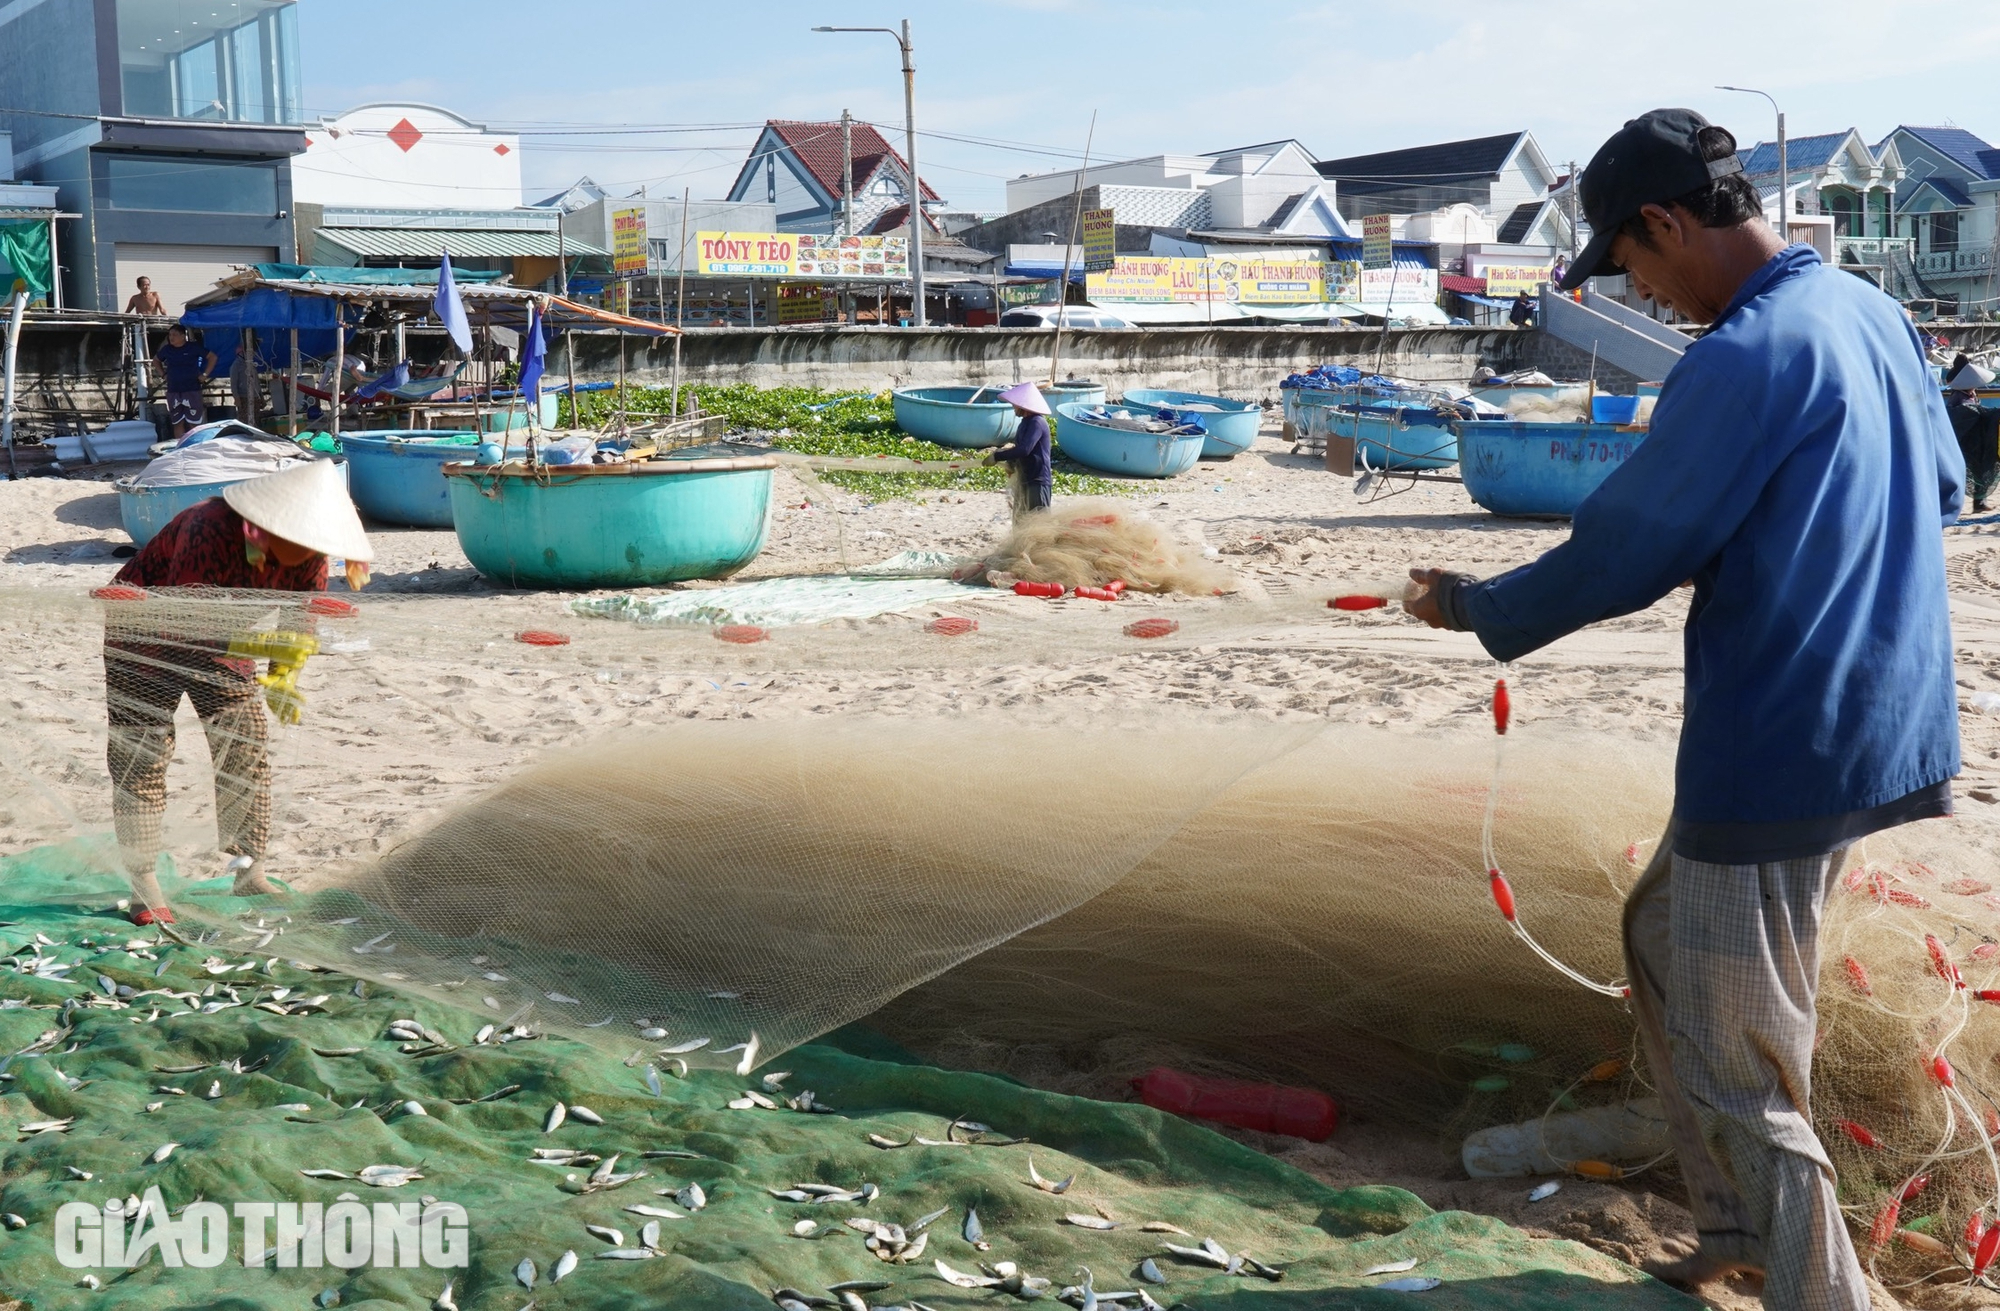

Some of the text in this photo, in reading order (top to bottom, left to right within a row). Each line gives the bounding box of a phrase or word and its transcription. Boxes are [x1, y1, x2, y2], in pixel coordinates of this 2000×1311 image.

[1084, 210, 1112, 220] THANH
[1364, 216, 1389, 225] THANH
[1084, 220, 1112, 231] HƯƠNG
[1364, 225, 1389, 235] HƯƠNG
[702, 235, 791, 261] TONY TÈO
[712, 264, 785, 273] ĐT: 0987.291.718
[1140, 261, 1169, 276] HƯƠNG
[1241, 262, 1324, 280] HÀU THANH HƯƠNG
[1491, 269, 1503, 279] Hàu
[1519, 269, 1536, 279] Thanh
[1363, 272, 1391, 283] THANH
[782, 286, 801, 299] TONY
